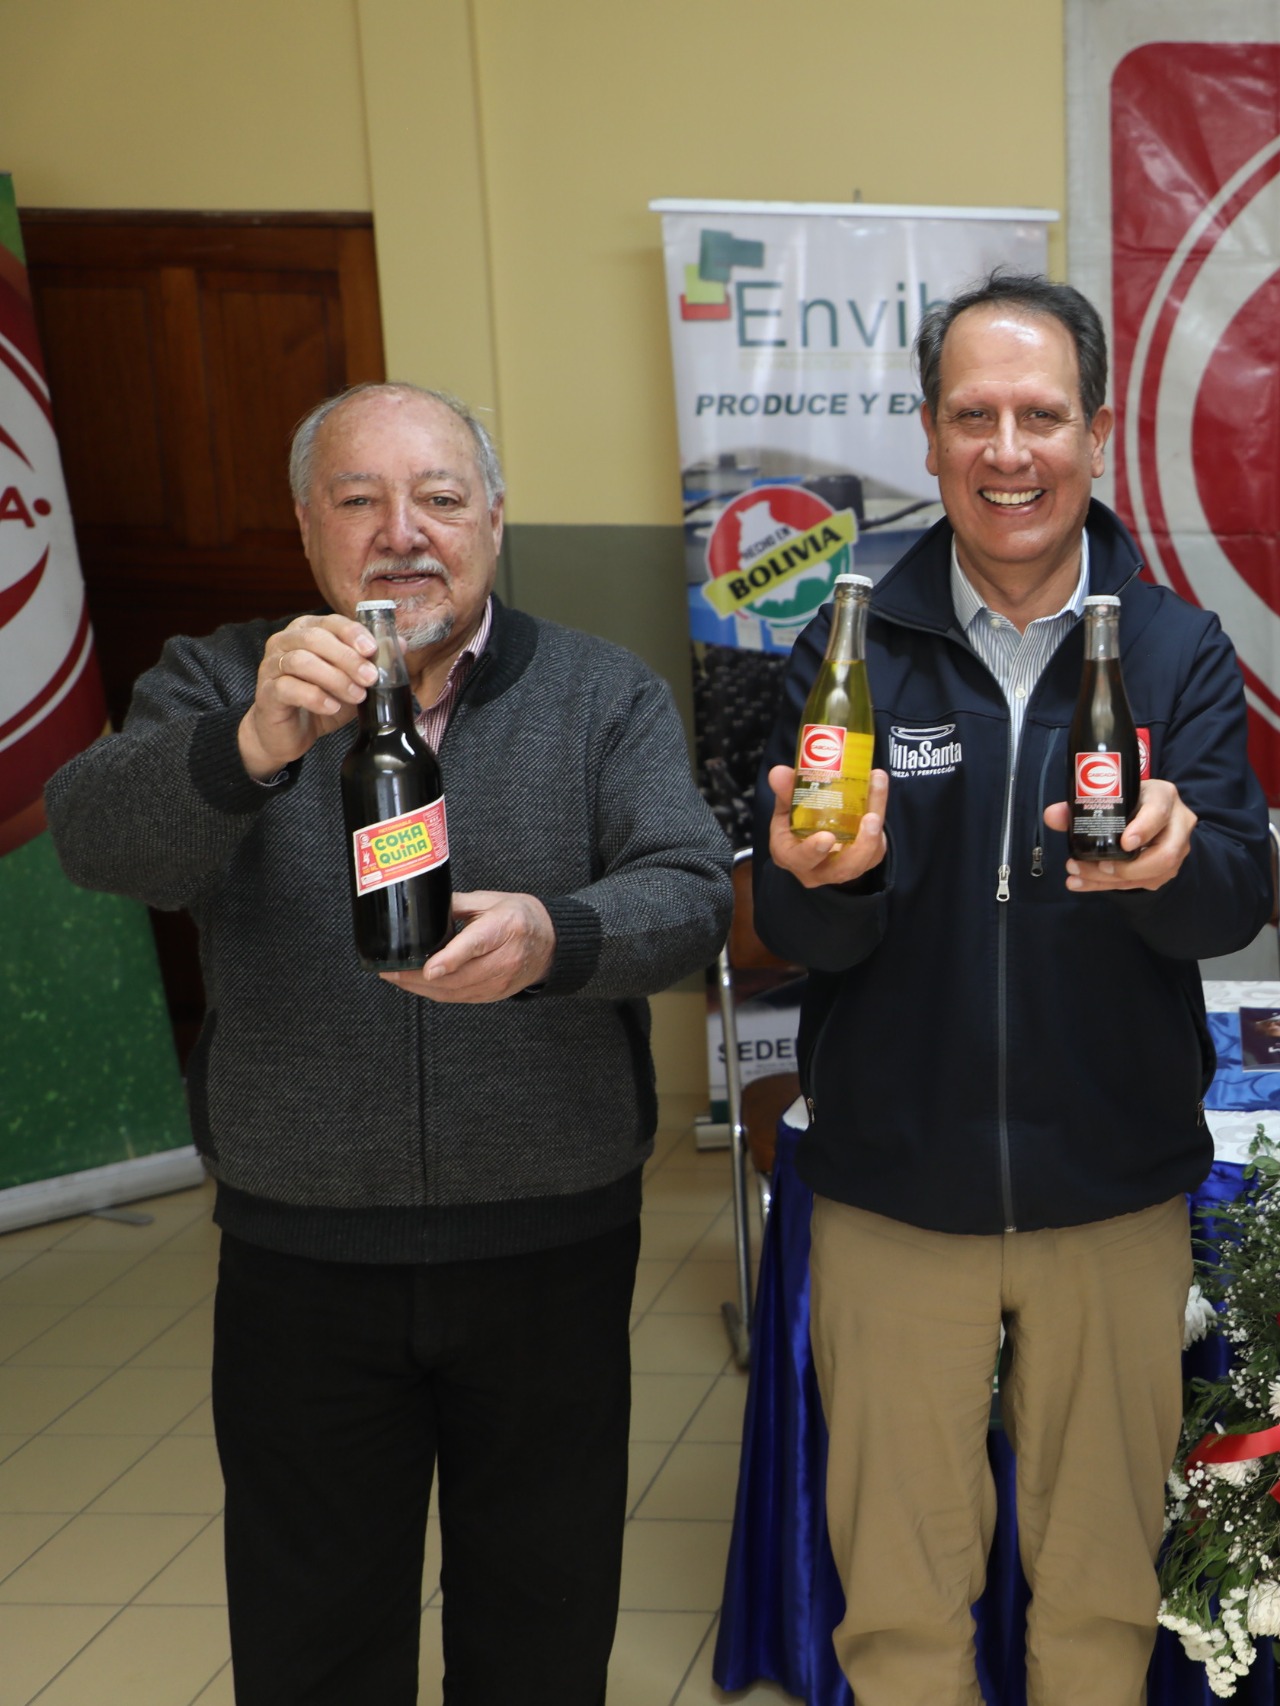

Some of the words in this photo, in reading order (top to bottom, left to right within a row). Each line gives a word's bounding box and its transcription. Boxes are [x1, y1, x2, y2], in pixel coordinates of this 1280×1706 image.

[696, 393, 848, 416] PRODUCE
[859, 393, 879, 415] Y
[728, 525, 843, 601] BOLIVIA
[374, 824, 424, 851] COKA
